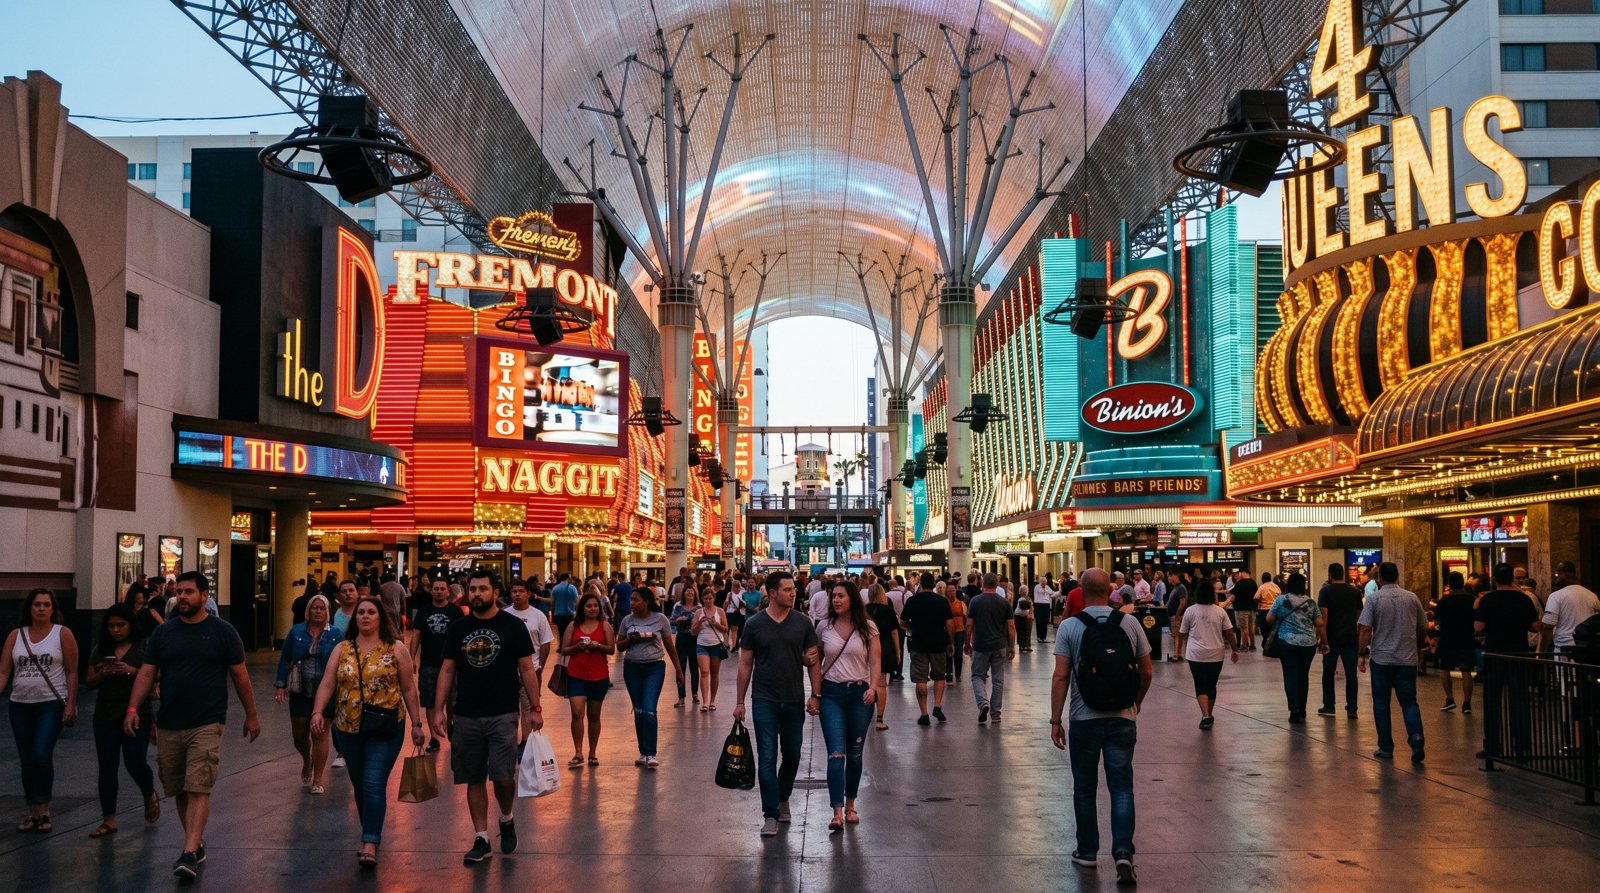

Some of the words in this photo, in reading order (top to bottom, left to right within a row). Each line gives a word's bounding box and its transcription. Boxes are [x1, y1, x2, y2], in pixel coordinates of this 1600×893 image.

[1311, 0, 1376, 127] 4
[282, 319, 324, 408] the
[335, 226, 386, 420] D
[392, 250, 619, 339] FREMONT
[1107, 269, 1174, 360] B
[495, 350, 516, 436] BINGO
[1090, 395, 1186, 424] Binion's
[244, 438, 285, 472] THE
[294, 445, 308, 475] D
[481, 456, 621, 497] NAGGIT
[1114, 480, 1144, 492] BARS
